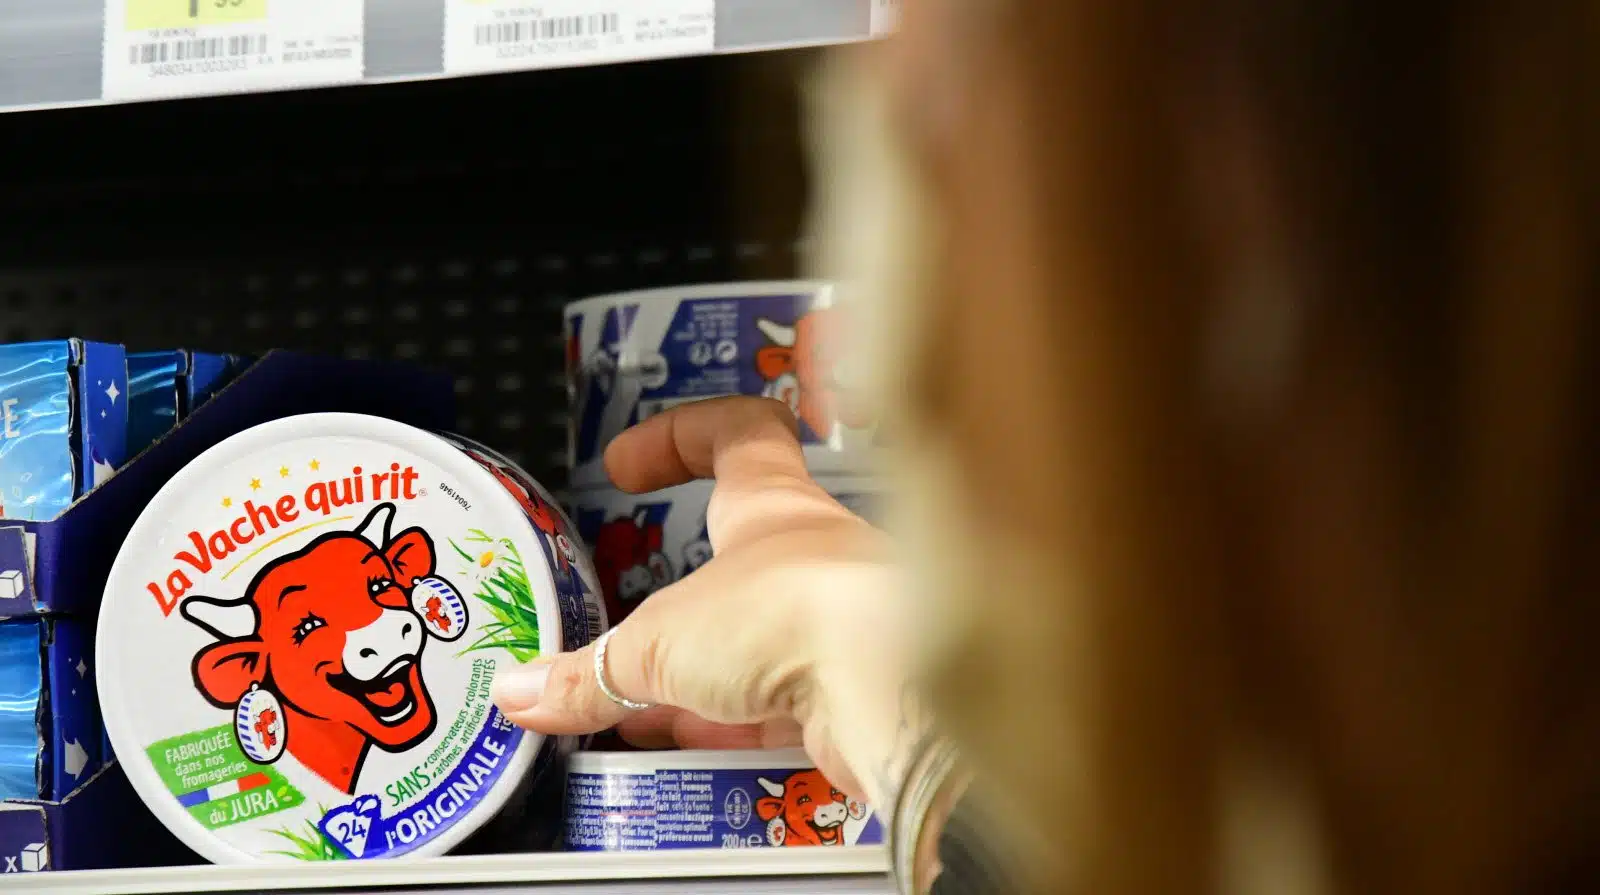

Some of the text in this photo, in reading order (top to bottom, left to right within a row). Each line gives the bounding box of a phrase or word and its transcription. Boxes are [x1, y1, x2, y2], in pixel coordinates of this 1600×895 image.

[439, 482, 471, 511] 76041946
[146, 462, 419, 618] La Vache qui rit
[427, 657, 483, 765] conservateurs colorants
[436, 658, 497, 775] arômes artificiels AJOUTÉS
[165, 731, 233, 764] FABRIQUÉE
[175, 752, 225, 776] dans nos
[182, 760, 248, 789] fromageries
[385, 765, 431, 807] SANS
[209, 788, 279, 825] du JURA
[338, 818, 367, 846] 24
